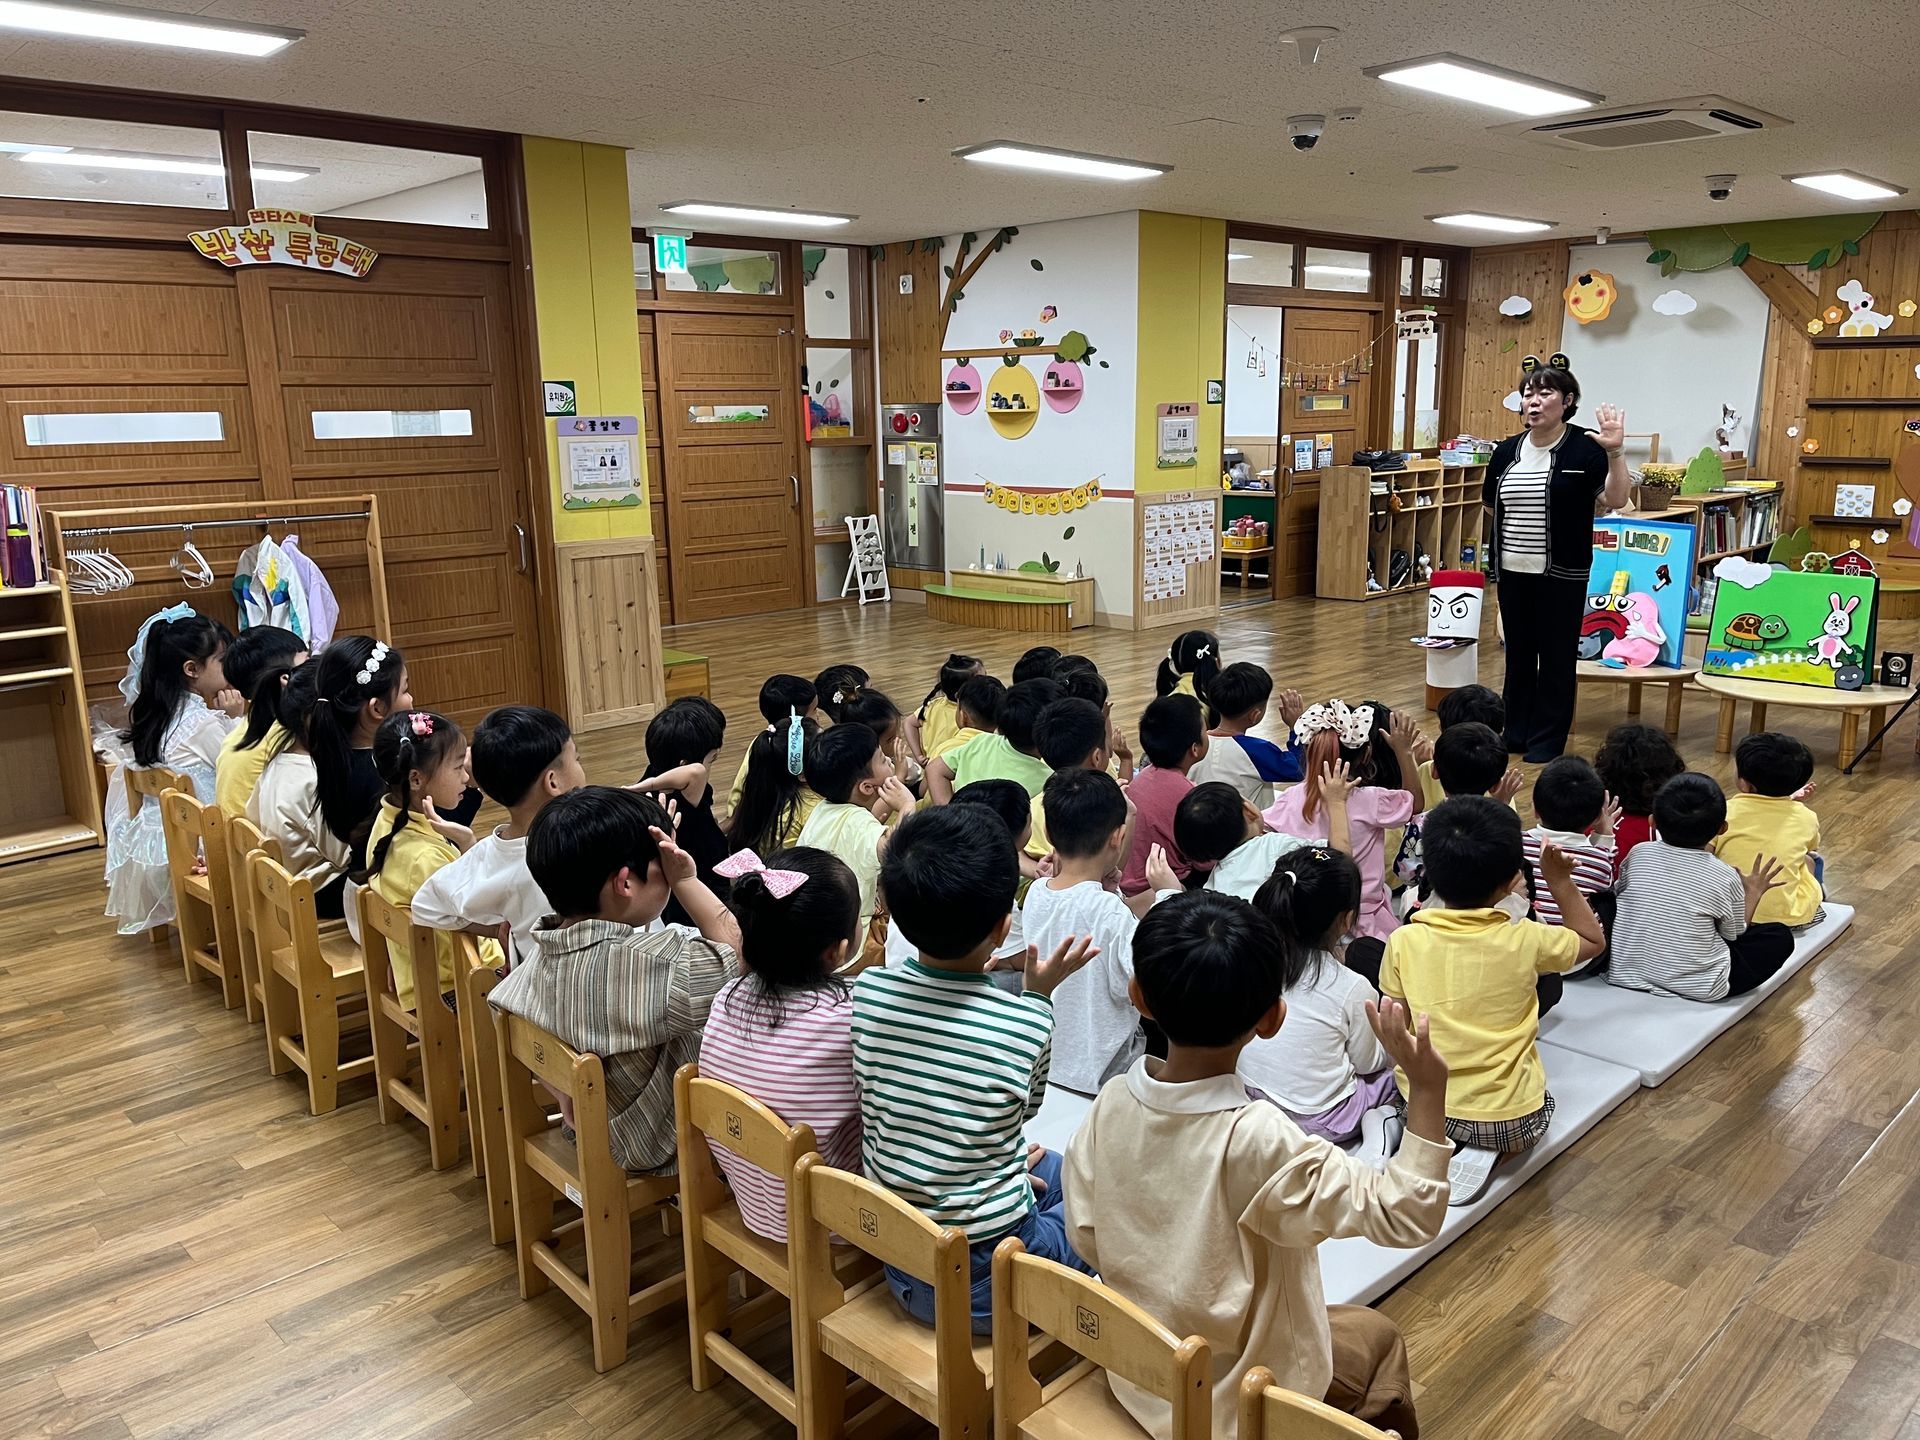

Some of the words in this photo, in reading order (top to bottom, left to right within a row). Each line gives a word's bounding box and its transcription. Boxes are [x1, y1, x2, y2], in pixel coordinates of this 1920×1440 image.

[250, 210, 313, 227] 판타스틱
[190, 228, 275, 264] 반찬
[285, 231, 376, 277] 특공대
